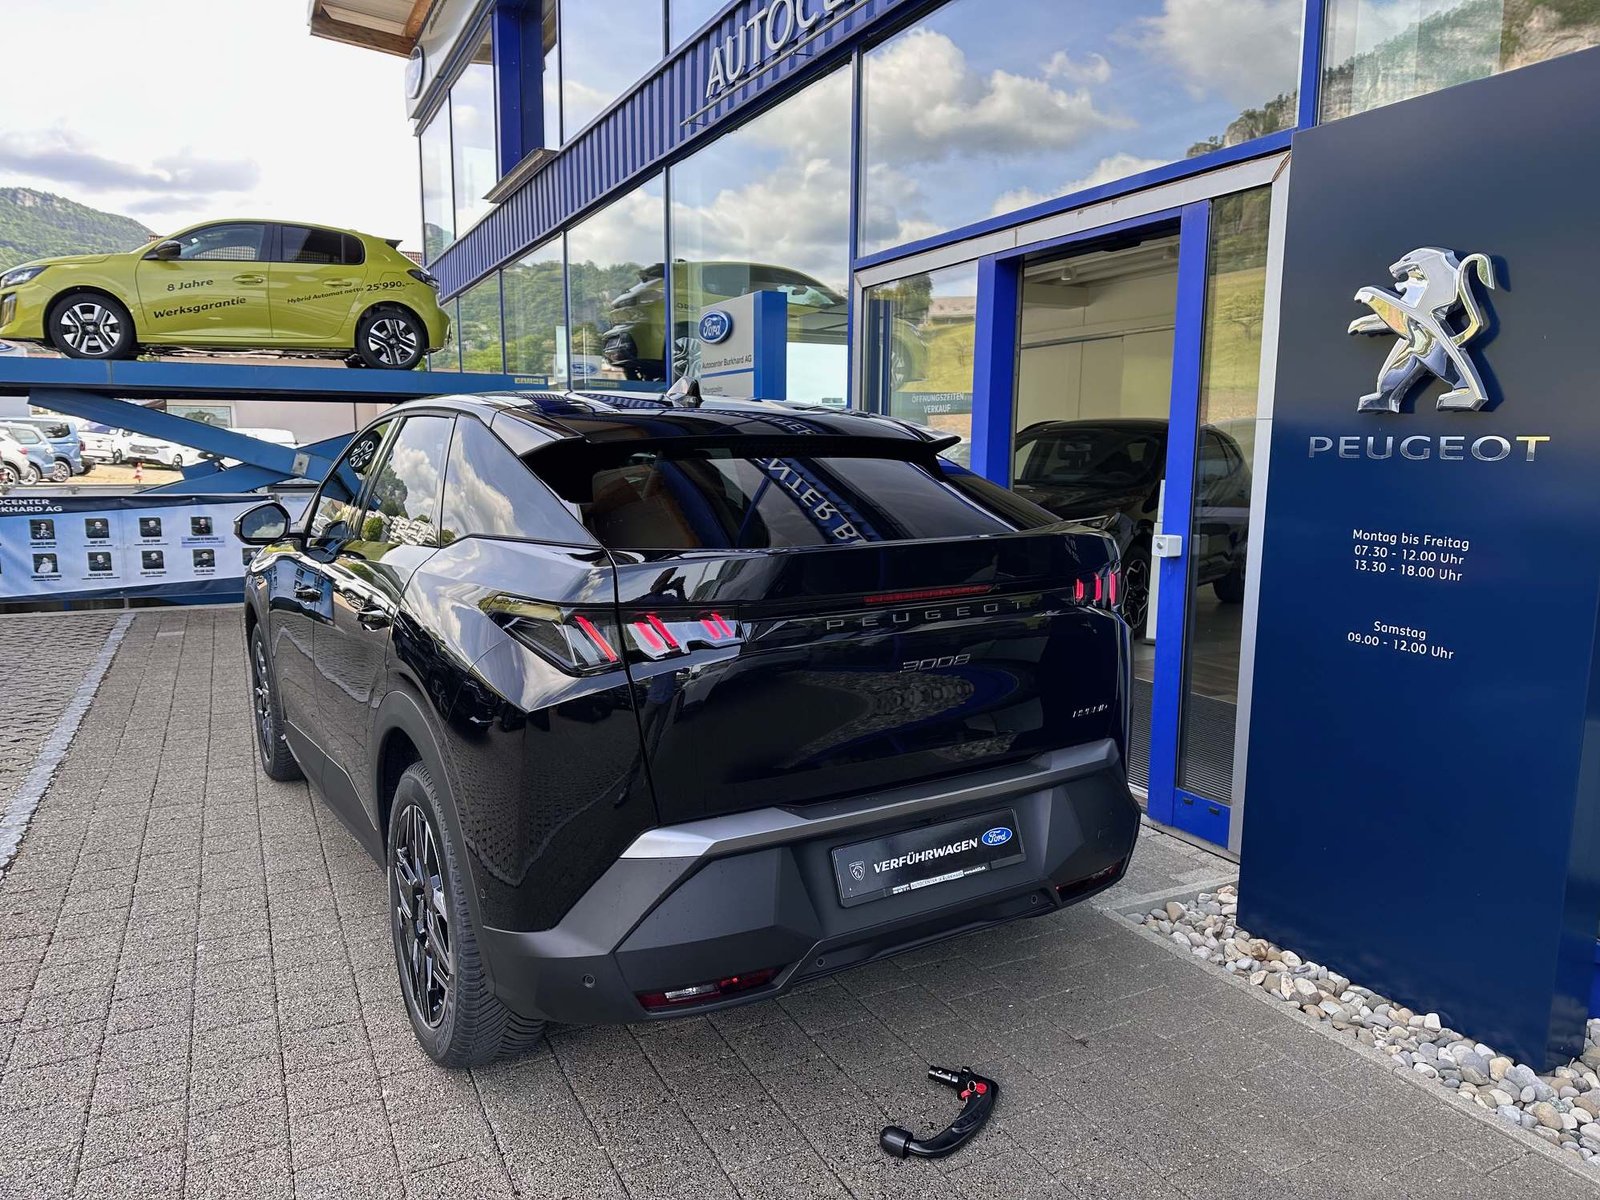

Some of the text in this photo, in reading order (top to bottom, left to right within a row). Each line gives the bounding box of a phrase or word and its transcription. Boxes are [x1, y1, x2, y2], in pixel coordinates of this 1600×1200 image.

[166, 279, 214, 292] 8 Jahre
[287, 295, 312, 305] Hybrid
[312, 290, 344, 300] Automat
[344, 287, 364, 295] netto
[153, 296, 247, 319] Werksgarantie
[744, 354, 752, 363] AG
[911, 392, 964, 404] ÖFFNUNGSZEITEN
[923, 403, 952, 414] VERKAUF
[1308, 435, 1551, 462] PEUGEOT
[1352, 529, 1470, 552] Montag bis Freitag
[1354, 544, 1388, 558] 07.30
[1402, 549, 1437, 562] 12.00
[1440, 552, 1465, 565] Uhr
[1354, 559, 1387, 573] 13.30
[1401, 564, 1435, 578] 18.00
[1439, 568, 1463, 581] Uhr
[826, 600, 1020, 631] PEUGEOT
[1373, 620, 1427, 641] Samstag
[1347, 631, 1379, 646] 09.00
[1393, 639, 1427, 655] 12.00
[1431, 645, 1454, 659] Uhr
[900, 653, 971, 673] 3008
[873, 829, 1008, 874] VERFÜHRWAGEN Ford
